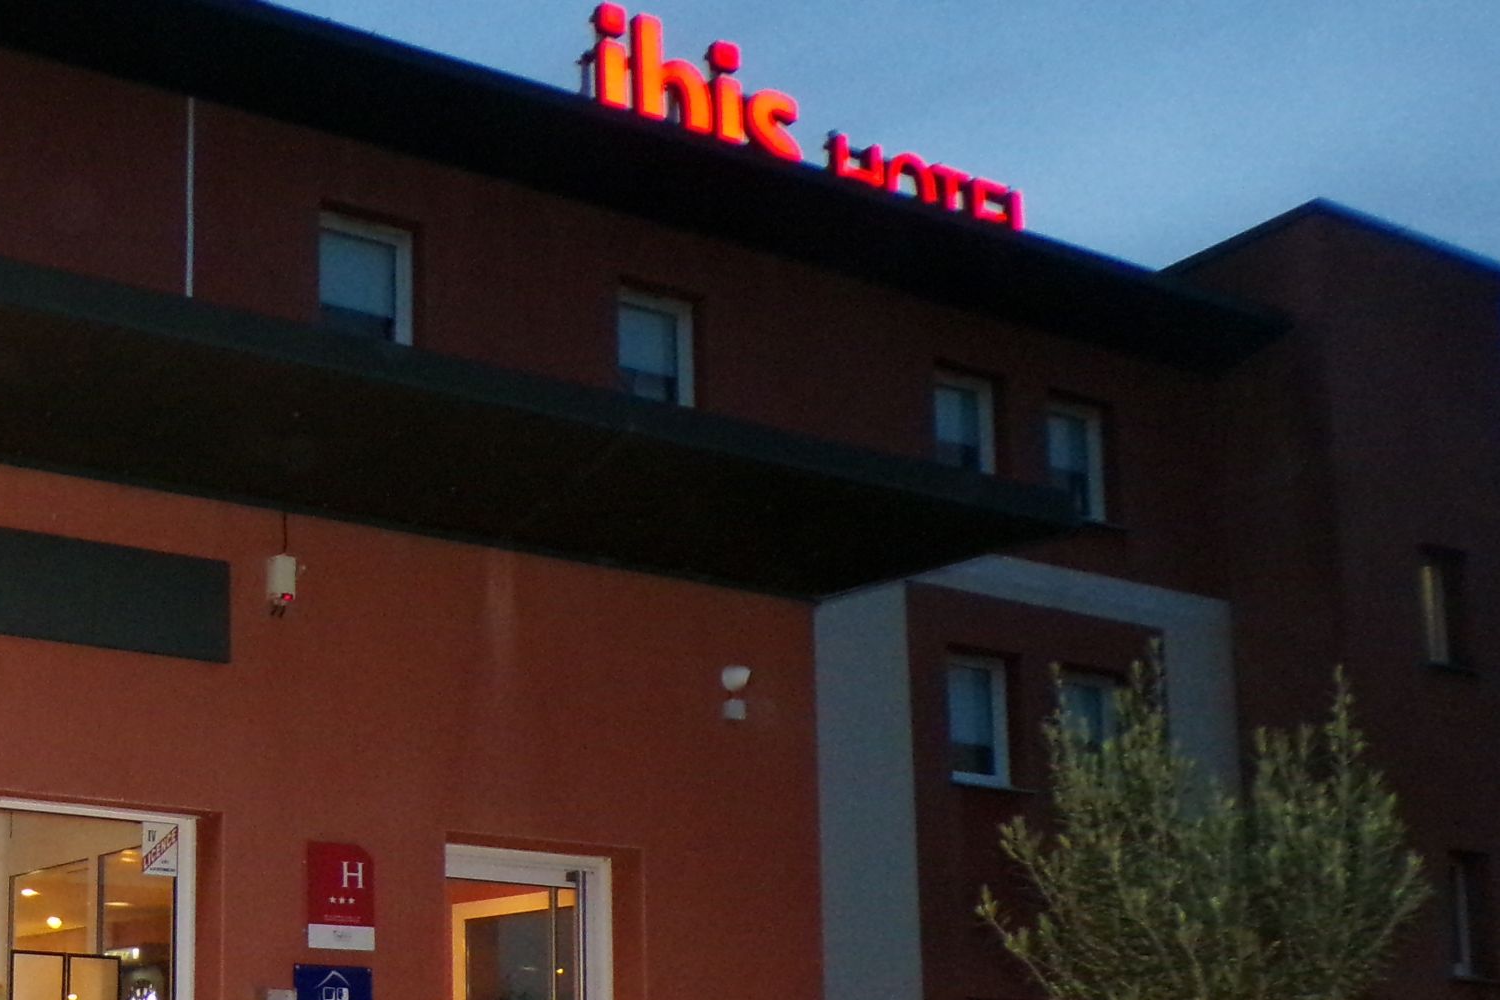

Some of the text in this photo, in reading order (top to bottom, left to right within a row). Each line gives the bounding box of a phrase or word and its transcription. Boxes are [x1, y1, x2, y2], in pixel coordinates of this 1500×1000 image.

[143, 828, 177, 870] LICENCE
[147, 829, 157, 842] IV
[341, 861, 364, 889] H
